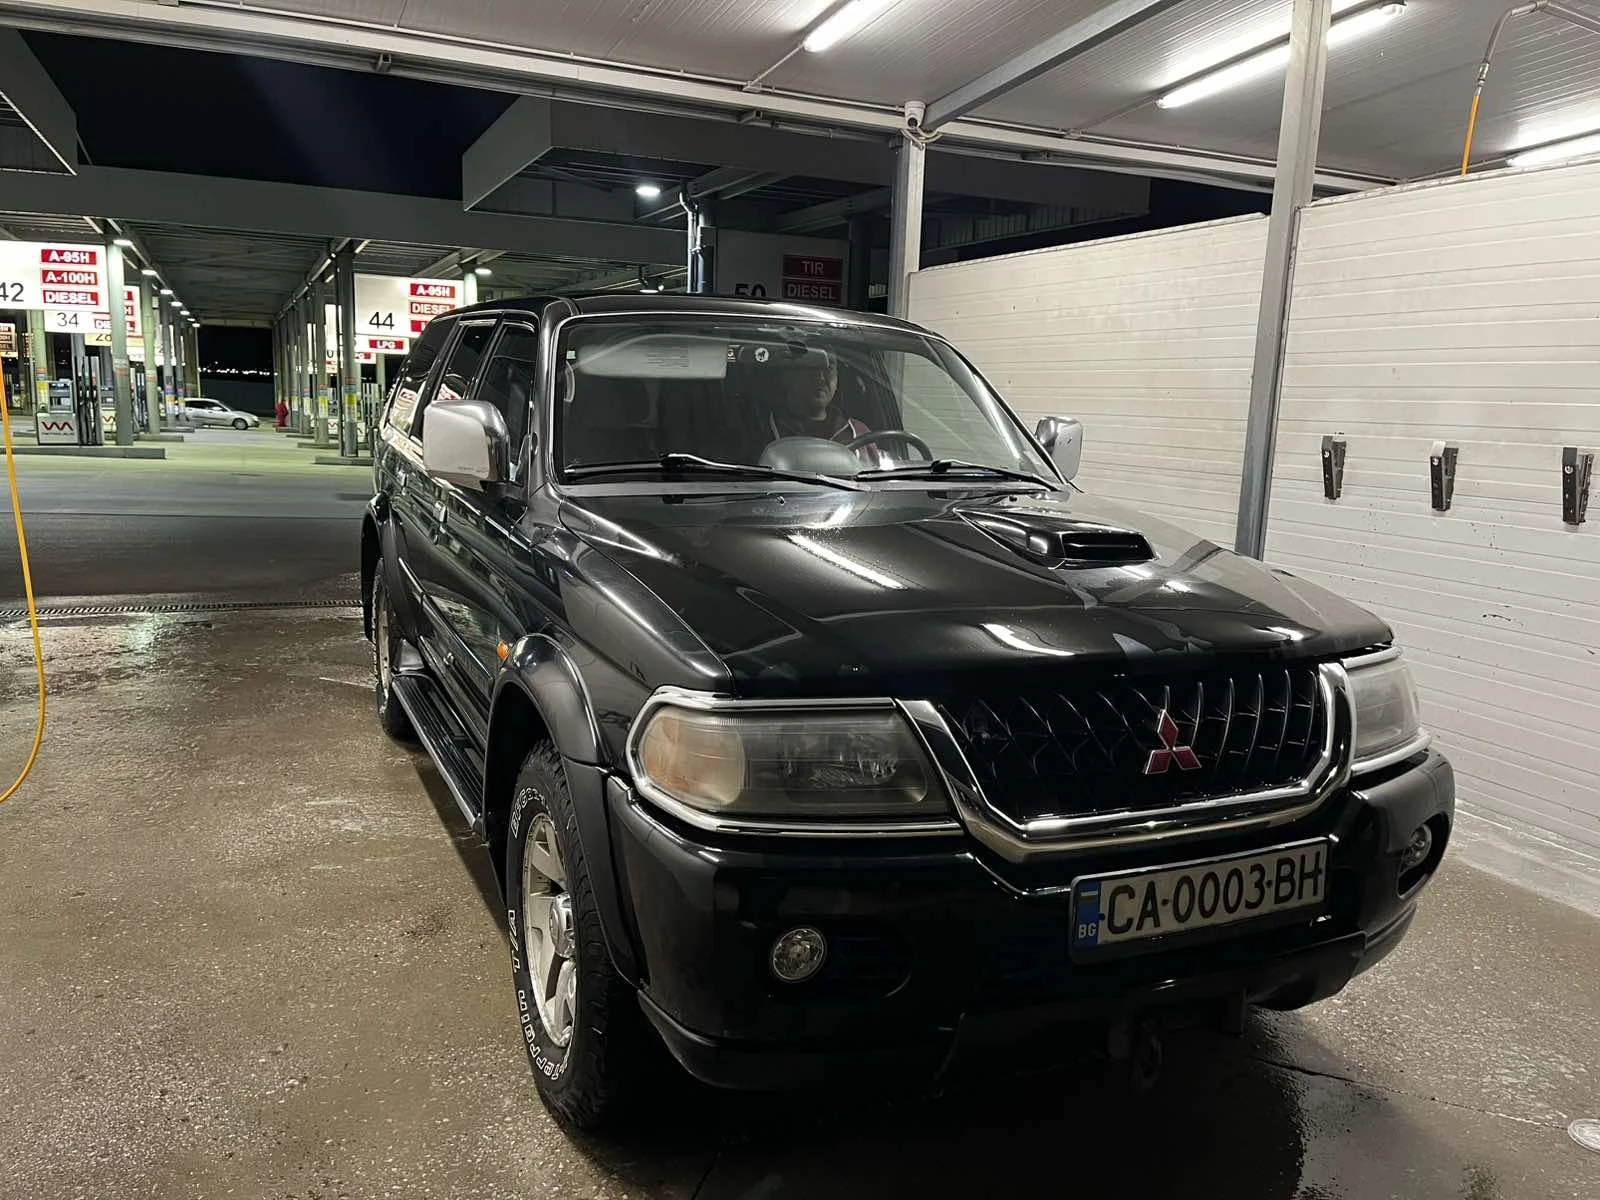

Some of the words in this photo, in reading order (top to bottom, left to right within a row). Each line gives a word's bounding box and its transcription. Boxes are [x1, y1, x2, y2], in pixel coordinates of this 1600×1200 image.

[50, 250, 90, 264] A-95H
[801, 261, 825, 275] TIR
[45, 271, 96, 284] A-100H
[0, 281, 25, 302] 42
[416, 284, 450, 297] A-95H
[787, 283, 838, 299] DIESEL
[45, 291, 97, 305] DIESEL
[56, 312, 80, 327] 34
[368, 311, 395, 330] 44
[376, 340, 396, 349] LPG
[1078, 923, 1097, 938] BG
